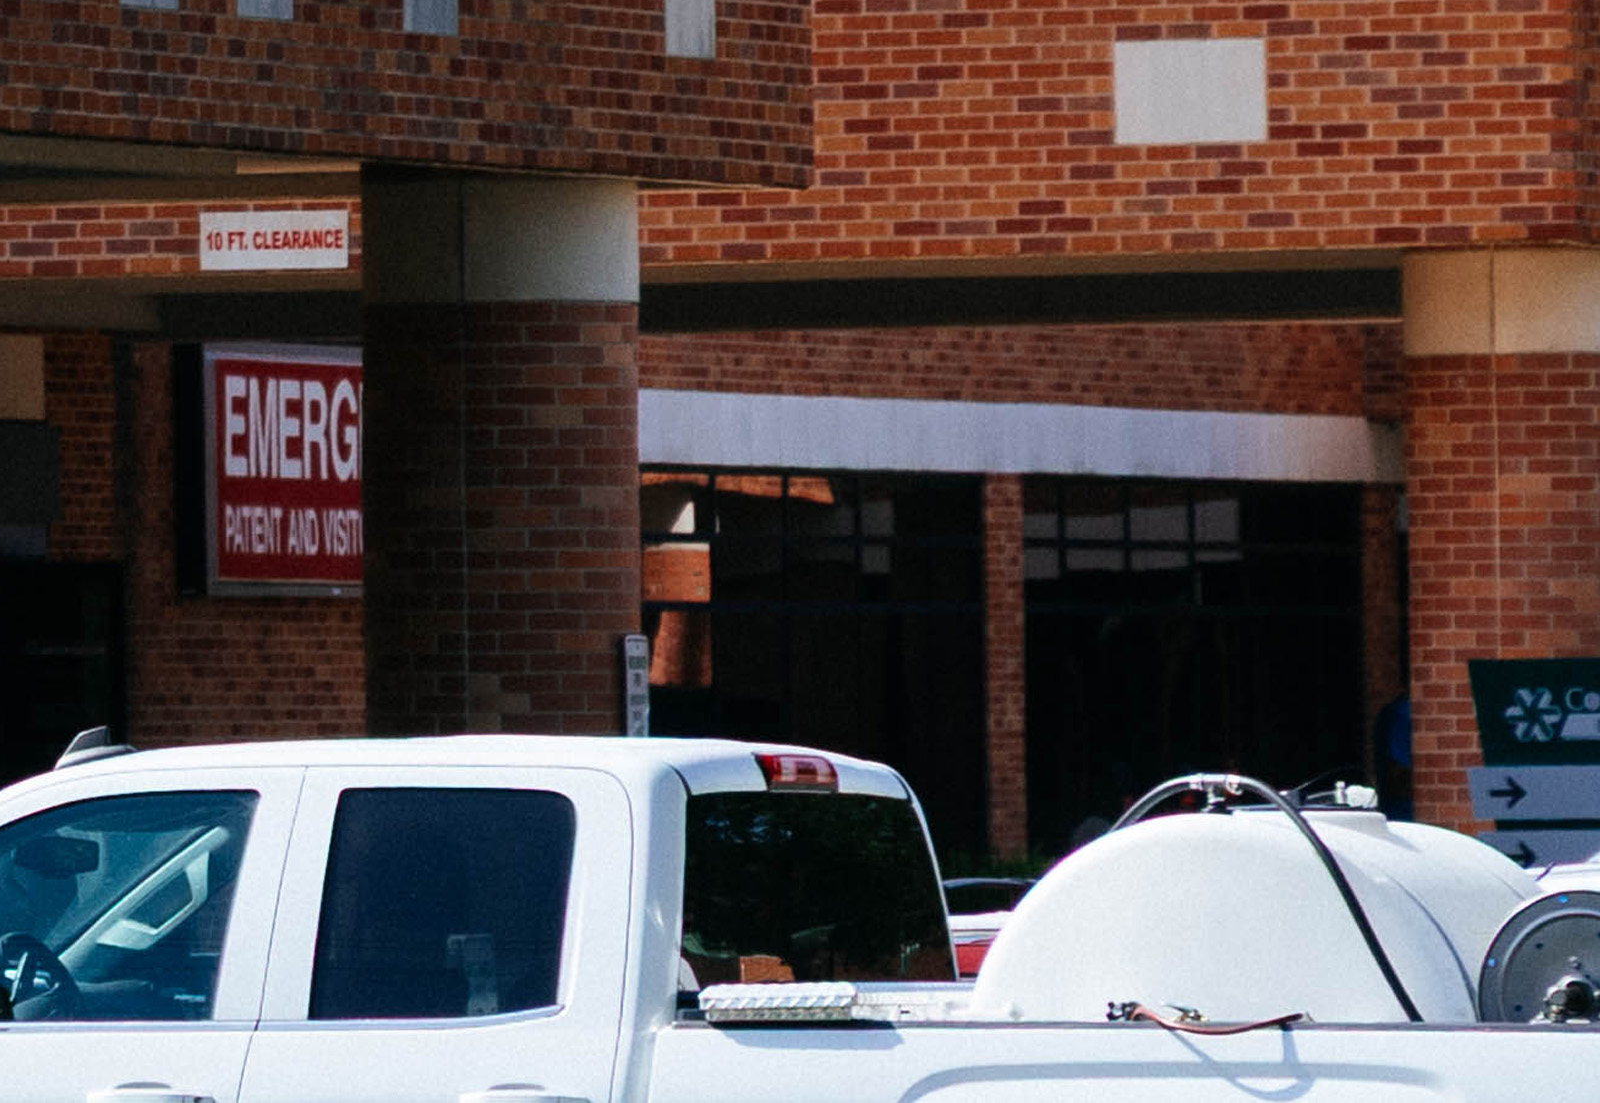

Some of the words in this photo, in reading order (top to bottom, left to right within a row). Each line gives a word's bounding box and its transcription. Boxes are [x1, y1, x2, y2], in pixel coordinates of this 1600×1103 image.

[206, 231, 223, 251] 10
[228, 231, 248, 250] FT.
[253, 229, 343, 250] CLEARANCE
[225, 374, 363, 482] EMERG
[225, 504, 283, 554] PATIENT
[288, 508, 319, 556] AND
[323, 508, 364, 557] VISIT
